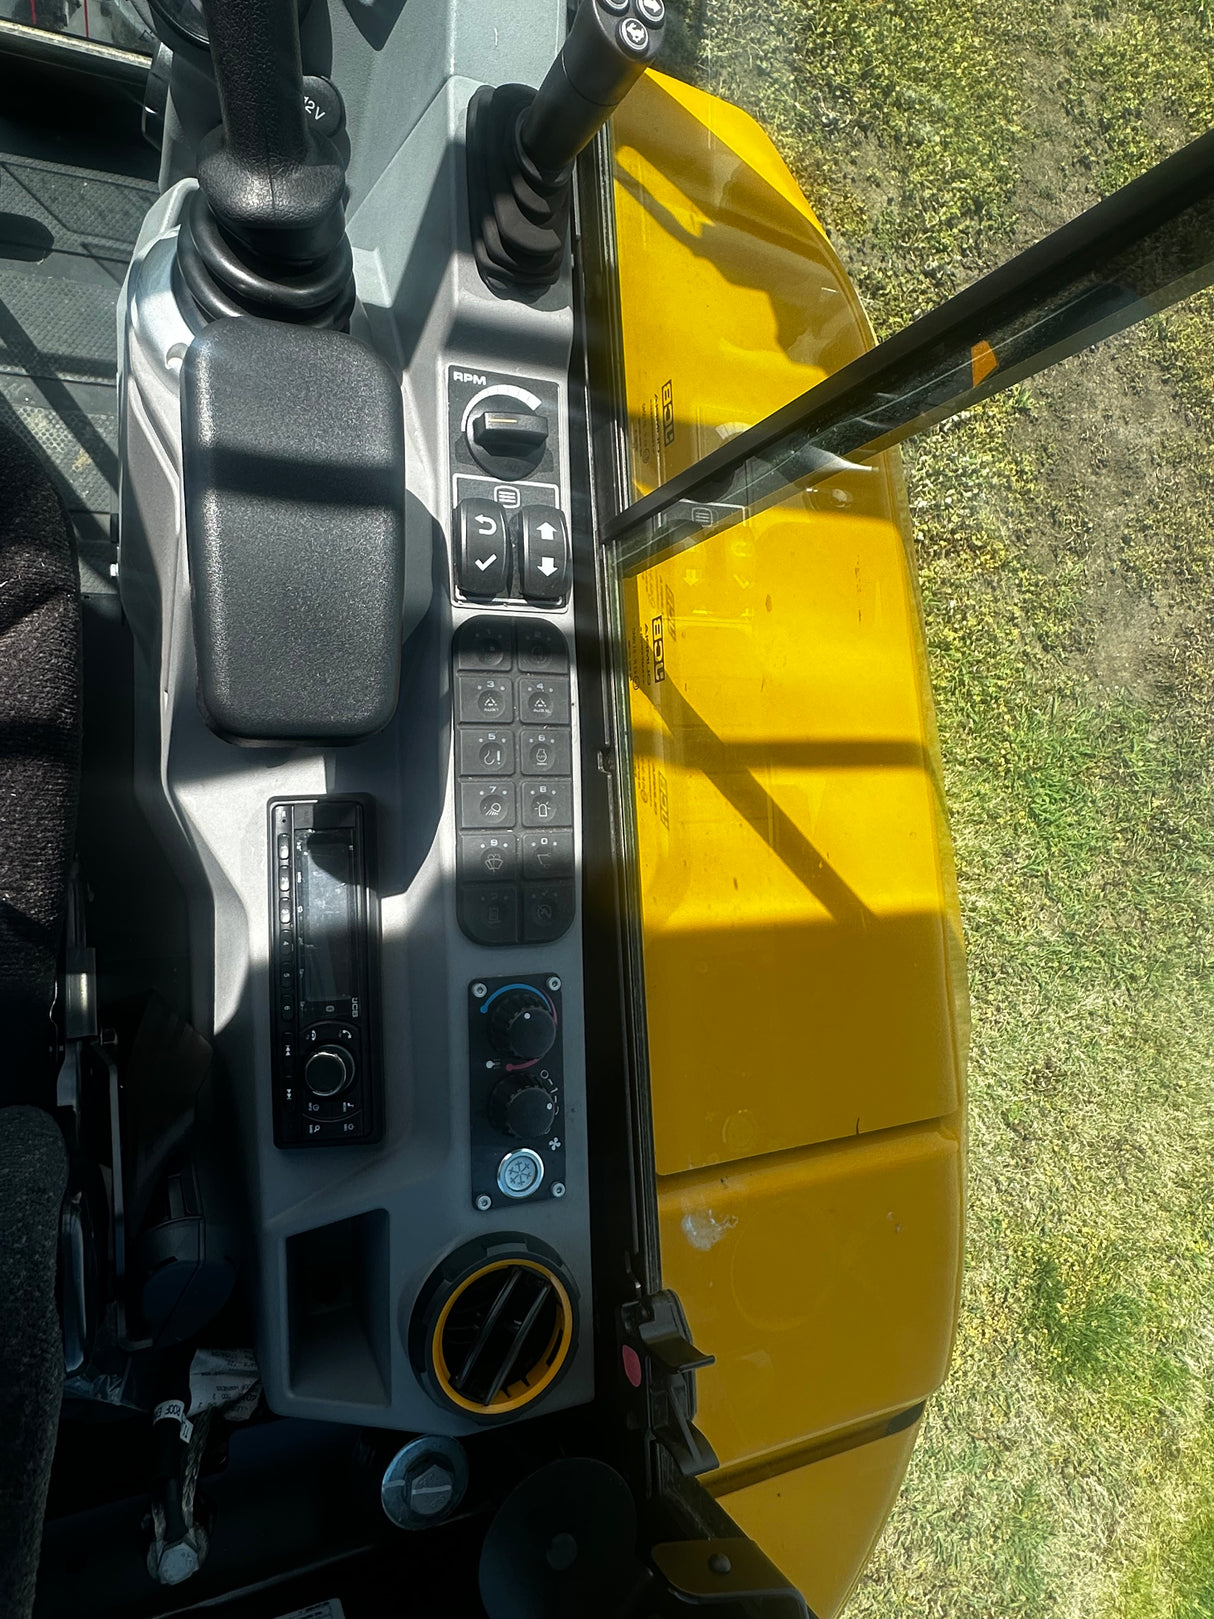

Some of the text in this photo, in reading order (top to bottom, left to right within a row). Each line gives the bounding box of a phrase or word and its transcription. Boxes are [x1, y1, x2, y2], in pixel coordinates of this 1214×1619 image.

[453, 371, 487, 386] RPM
[486, 680, 495, 688] 3
[536, 682, 545, 690] 4
[487, 732, 496, 740] 5
[488, 785, 497, 793] 7
[539, 785, 547, 793] 8
[490, 838, 498, 847] 9
